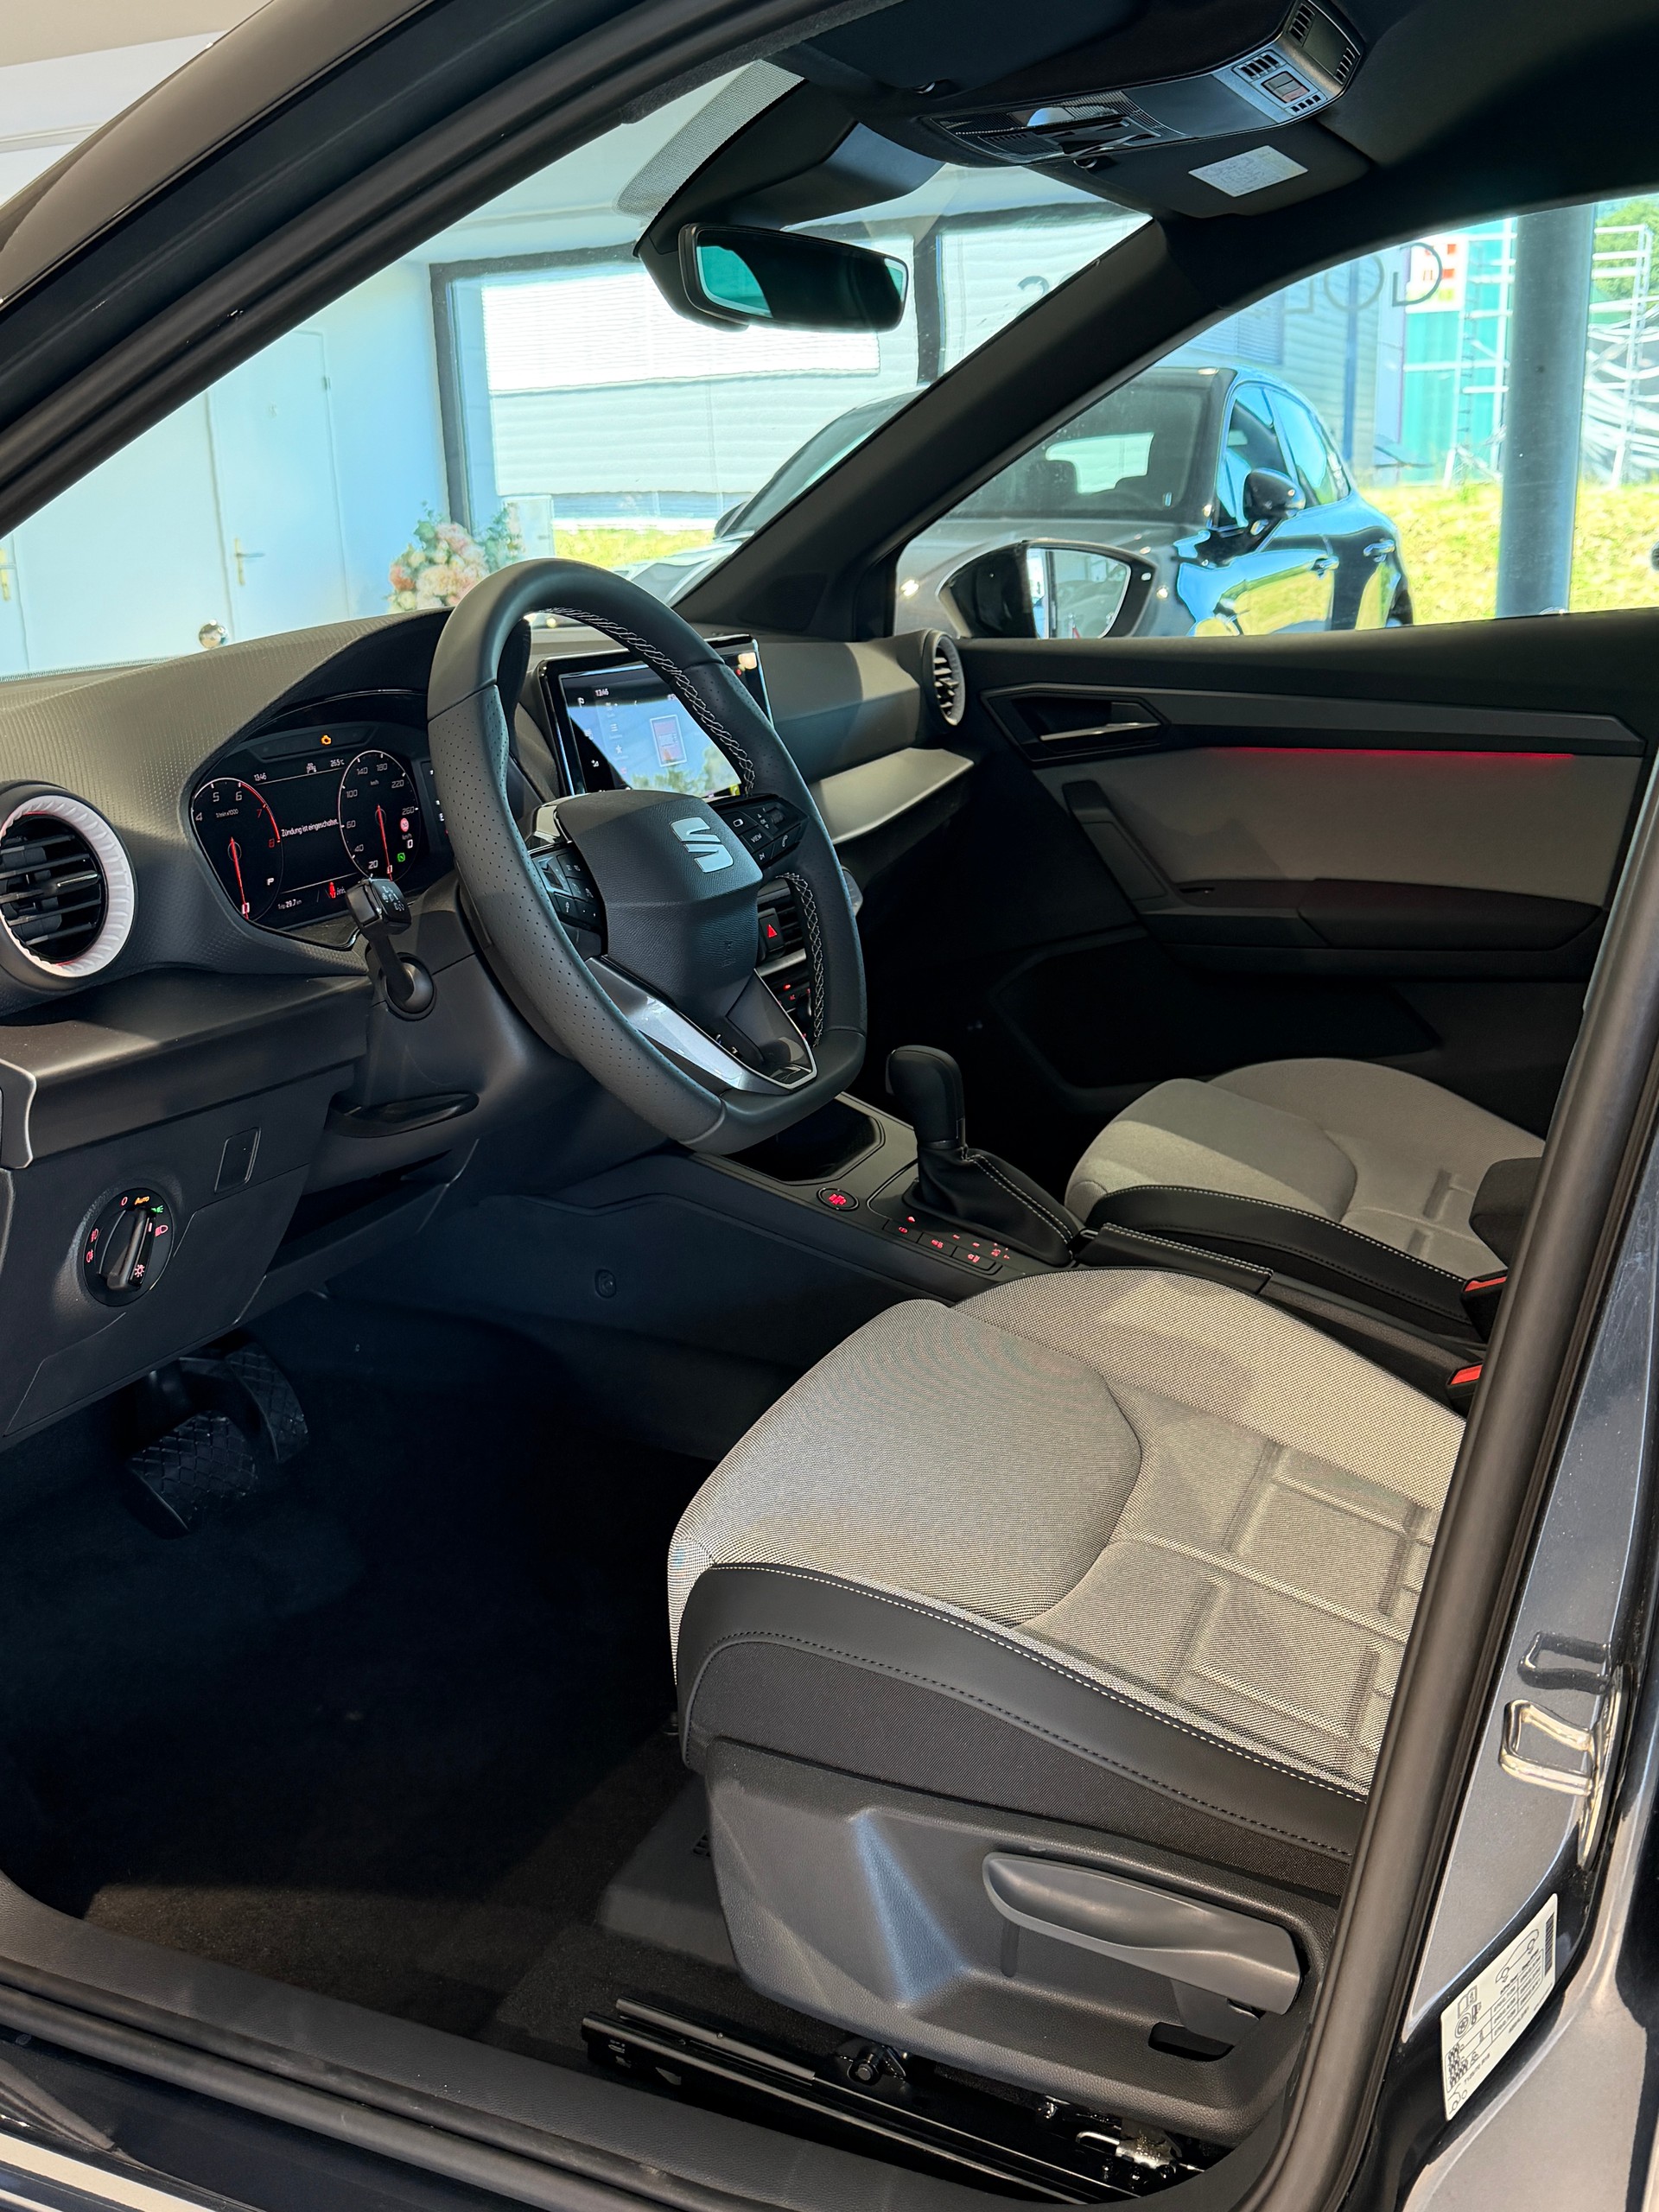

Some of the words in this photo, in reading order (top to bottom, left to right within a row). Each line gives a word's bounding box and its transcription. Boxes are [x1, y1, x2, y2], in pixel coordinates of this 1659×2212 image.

[356, 766, 368, 776] 140
[391, 779, 404, 789] 220
[213, 791, 219, 803] 5
[235, 791, 243, 802] 6
[346, 789, 358, 798] 100
[402, 806, 415, 816] 260
[195, 812, 203, 822] 4
[346, 820, 356, 830] 60
[354, 844, 364, 853] 40
[368, 860, 378, 870] 20
[267, 878, 275, 887] P
